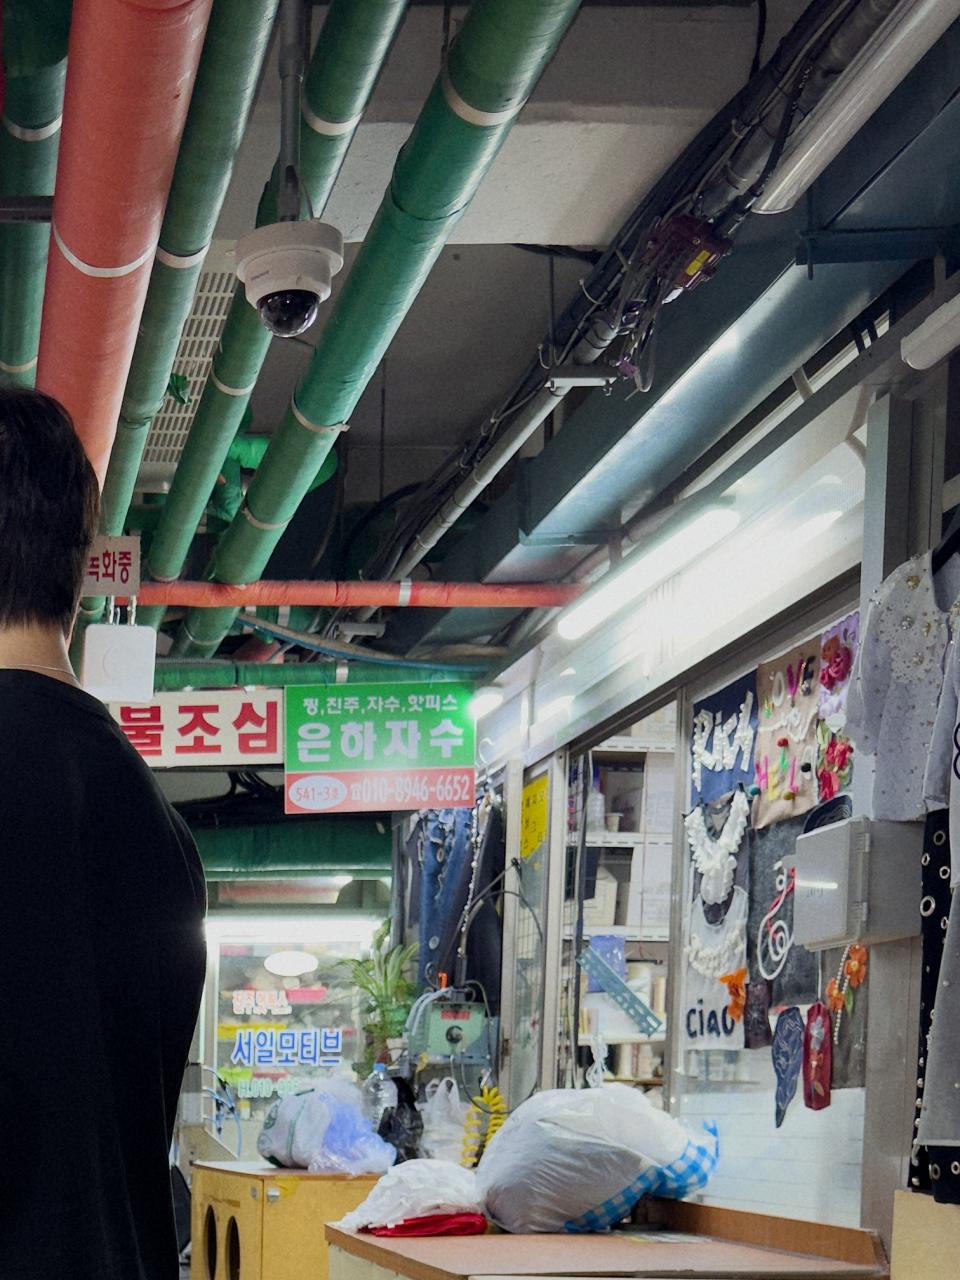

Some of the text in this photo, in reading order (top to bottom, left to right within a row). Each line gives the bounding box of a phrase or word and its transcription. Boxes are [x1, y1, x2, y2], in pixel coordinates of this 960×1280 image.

[120, 701, 278, 756] 불조심
[297, 719, 464, 763] 은하자수
[232, 1030, 341, 1065] 서일모티브
